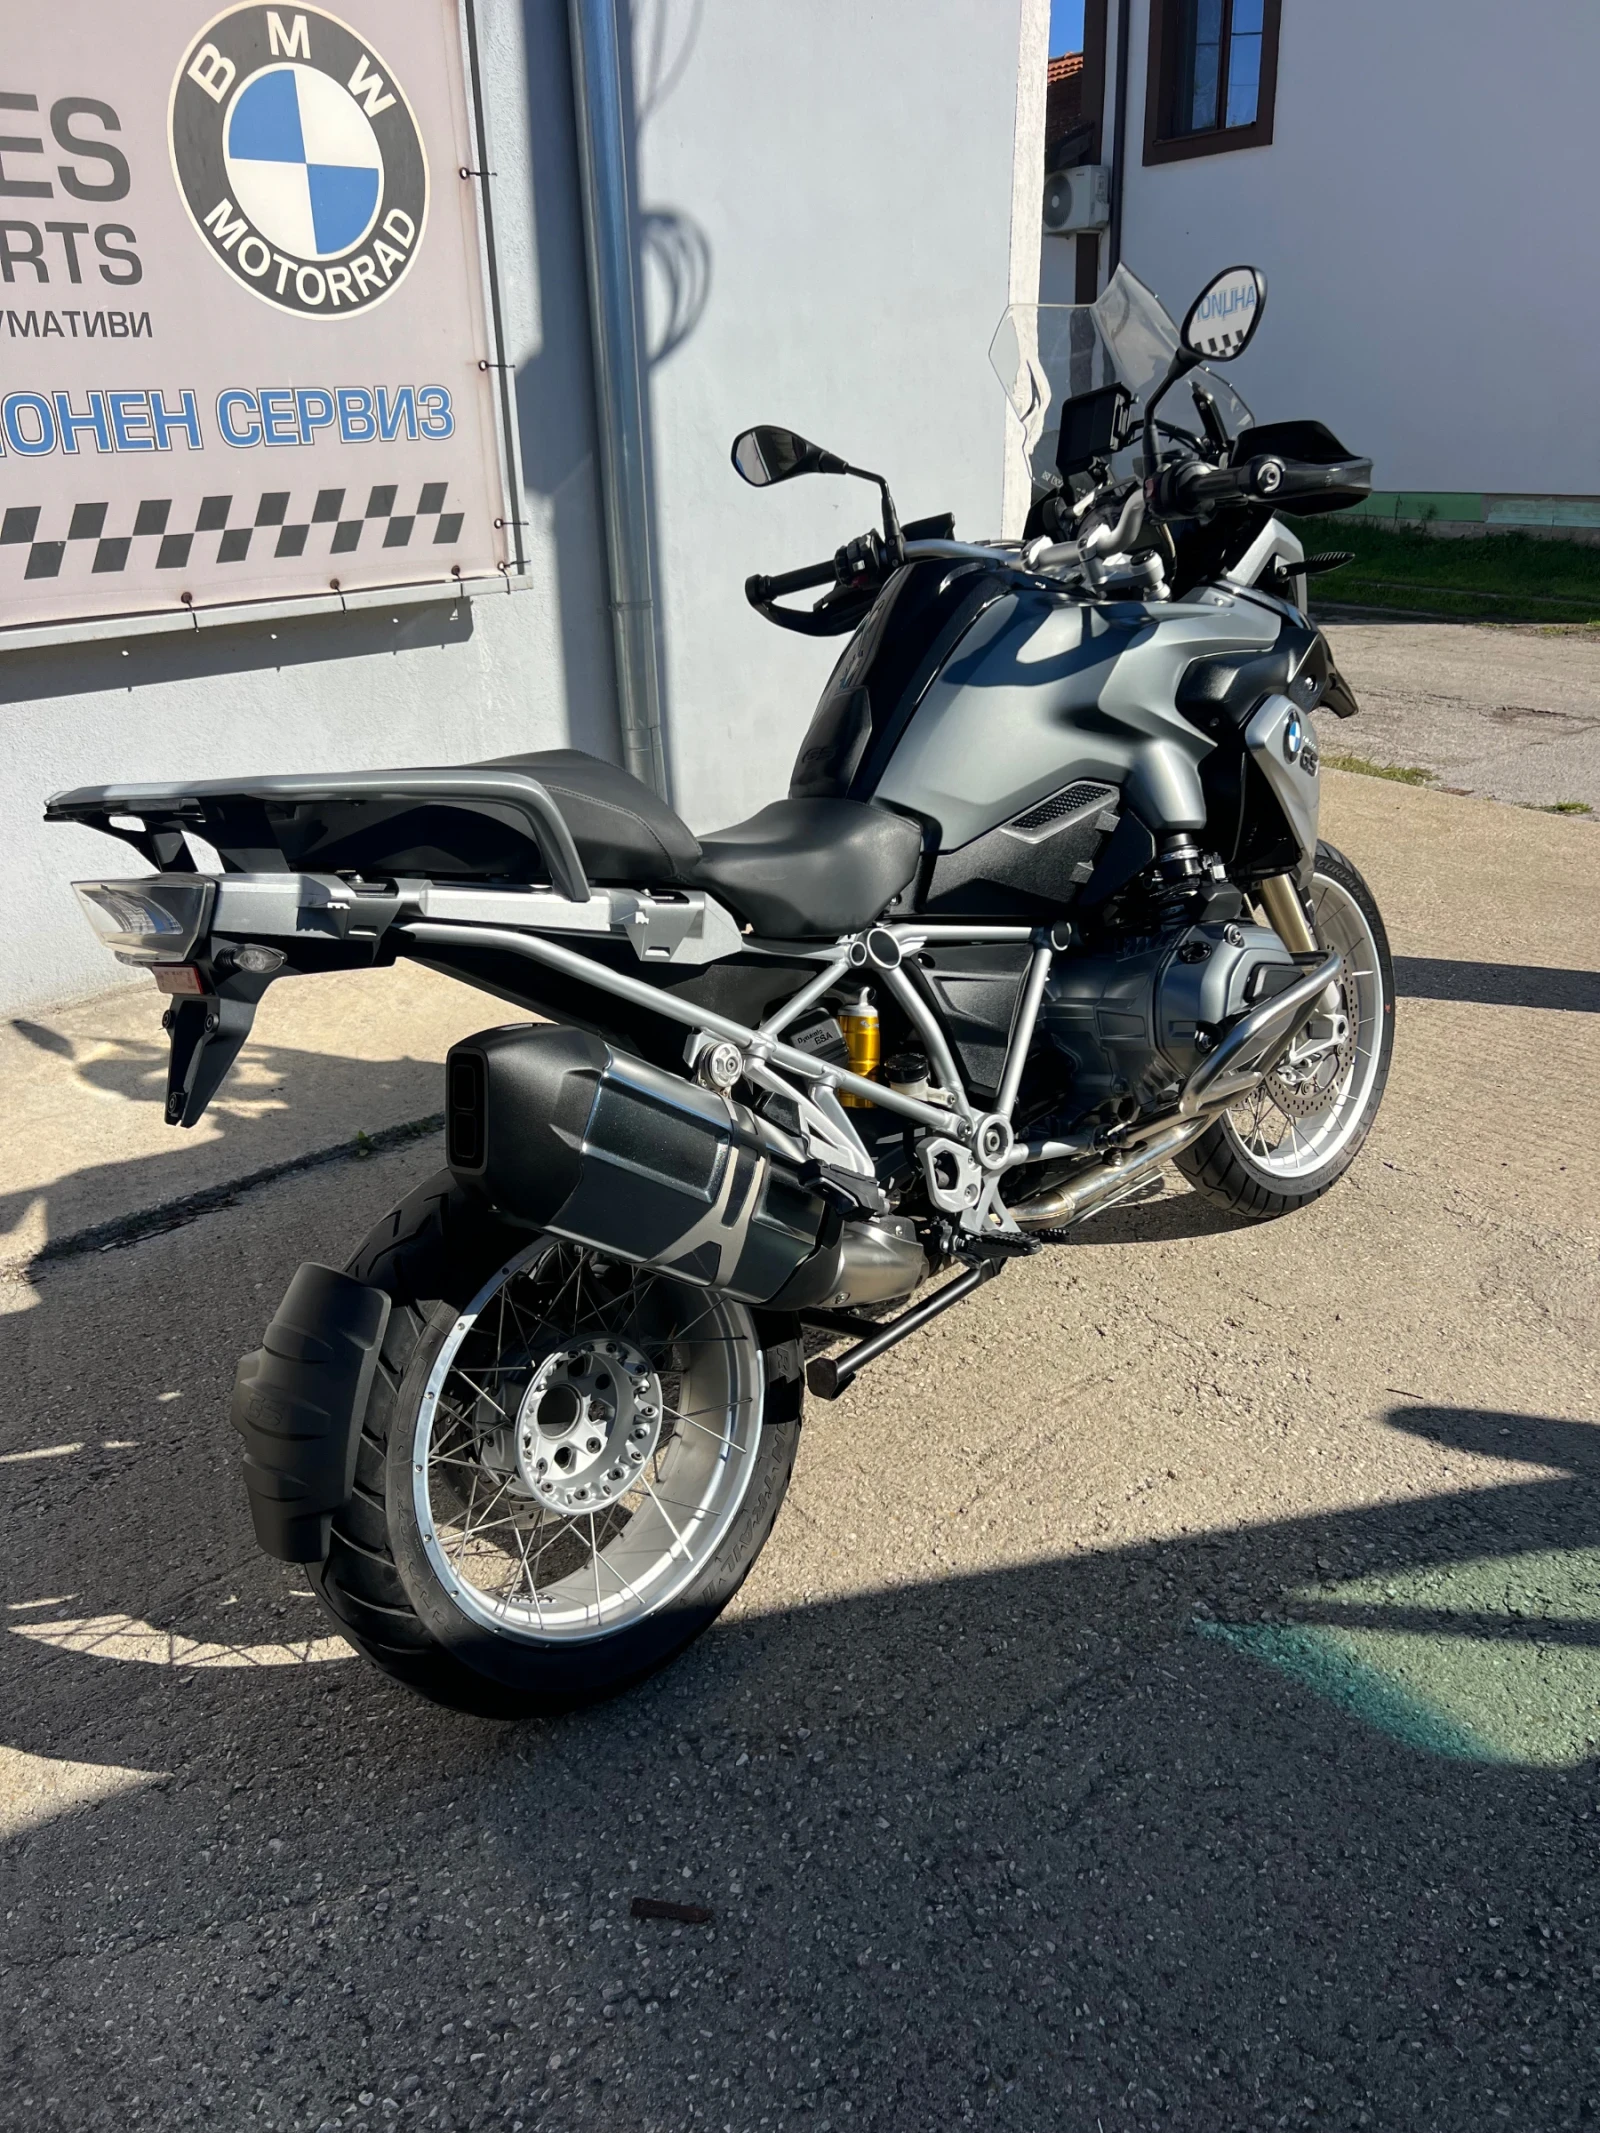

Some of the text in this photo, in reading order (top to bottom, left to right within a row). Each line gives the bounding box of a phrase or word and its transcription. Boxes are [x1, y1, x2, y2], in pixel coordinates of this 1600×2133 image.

[187, 11, 397, 118] BMW
[0, 91, 131, 202] ES
[0, 220, 143, 286] RTS
[204, 198, 416, 306] MOTORRAD
[0, 310, 153, 338] МАТИВИ
[0, 384, 456, 458] ОНЕН СЕРВИЗ
[814, 1032, 833, 1045] ESA
